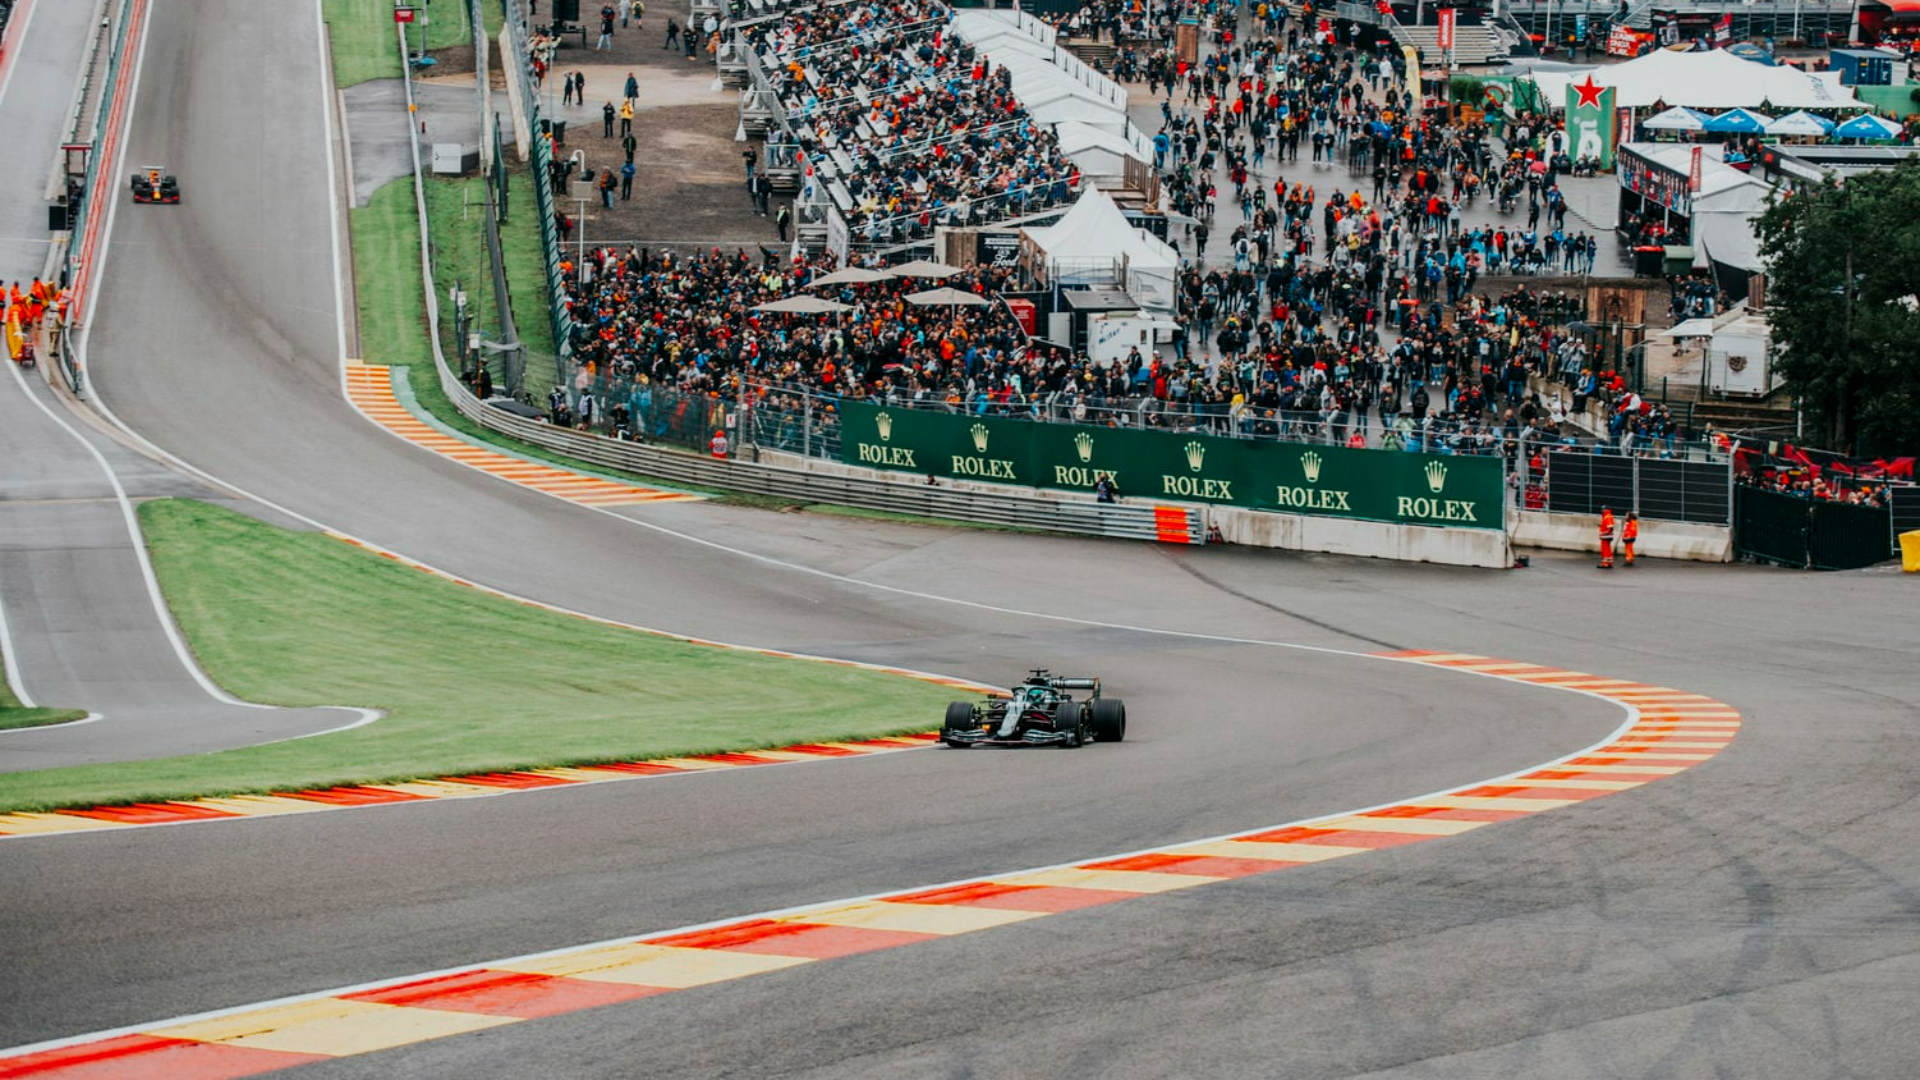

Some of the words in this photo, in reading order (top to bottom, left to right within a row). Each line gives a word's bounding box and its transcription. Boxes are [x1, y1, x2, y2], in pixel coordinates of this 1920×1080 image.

[858, 443, 916, 467] ROLEX
[951, 455, 1016, 479] ROLEX
[1162, 475, 1234, 500] ROLEX
[1277, 486, 1351, 511] ROLEX
[1397, 496, 1478, 522] ROLEX
